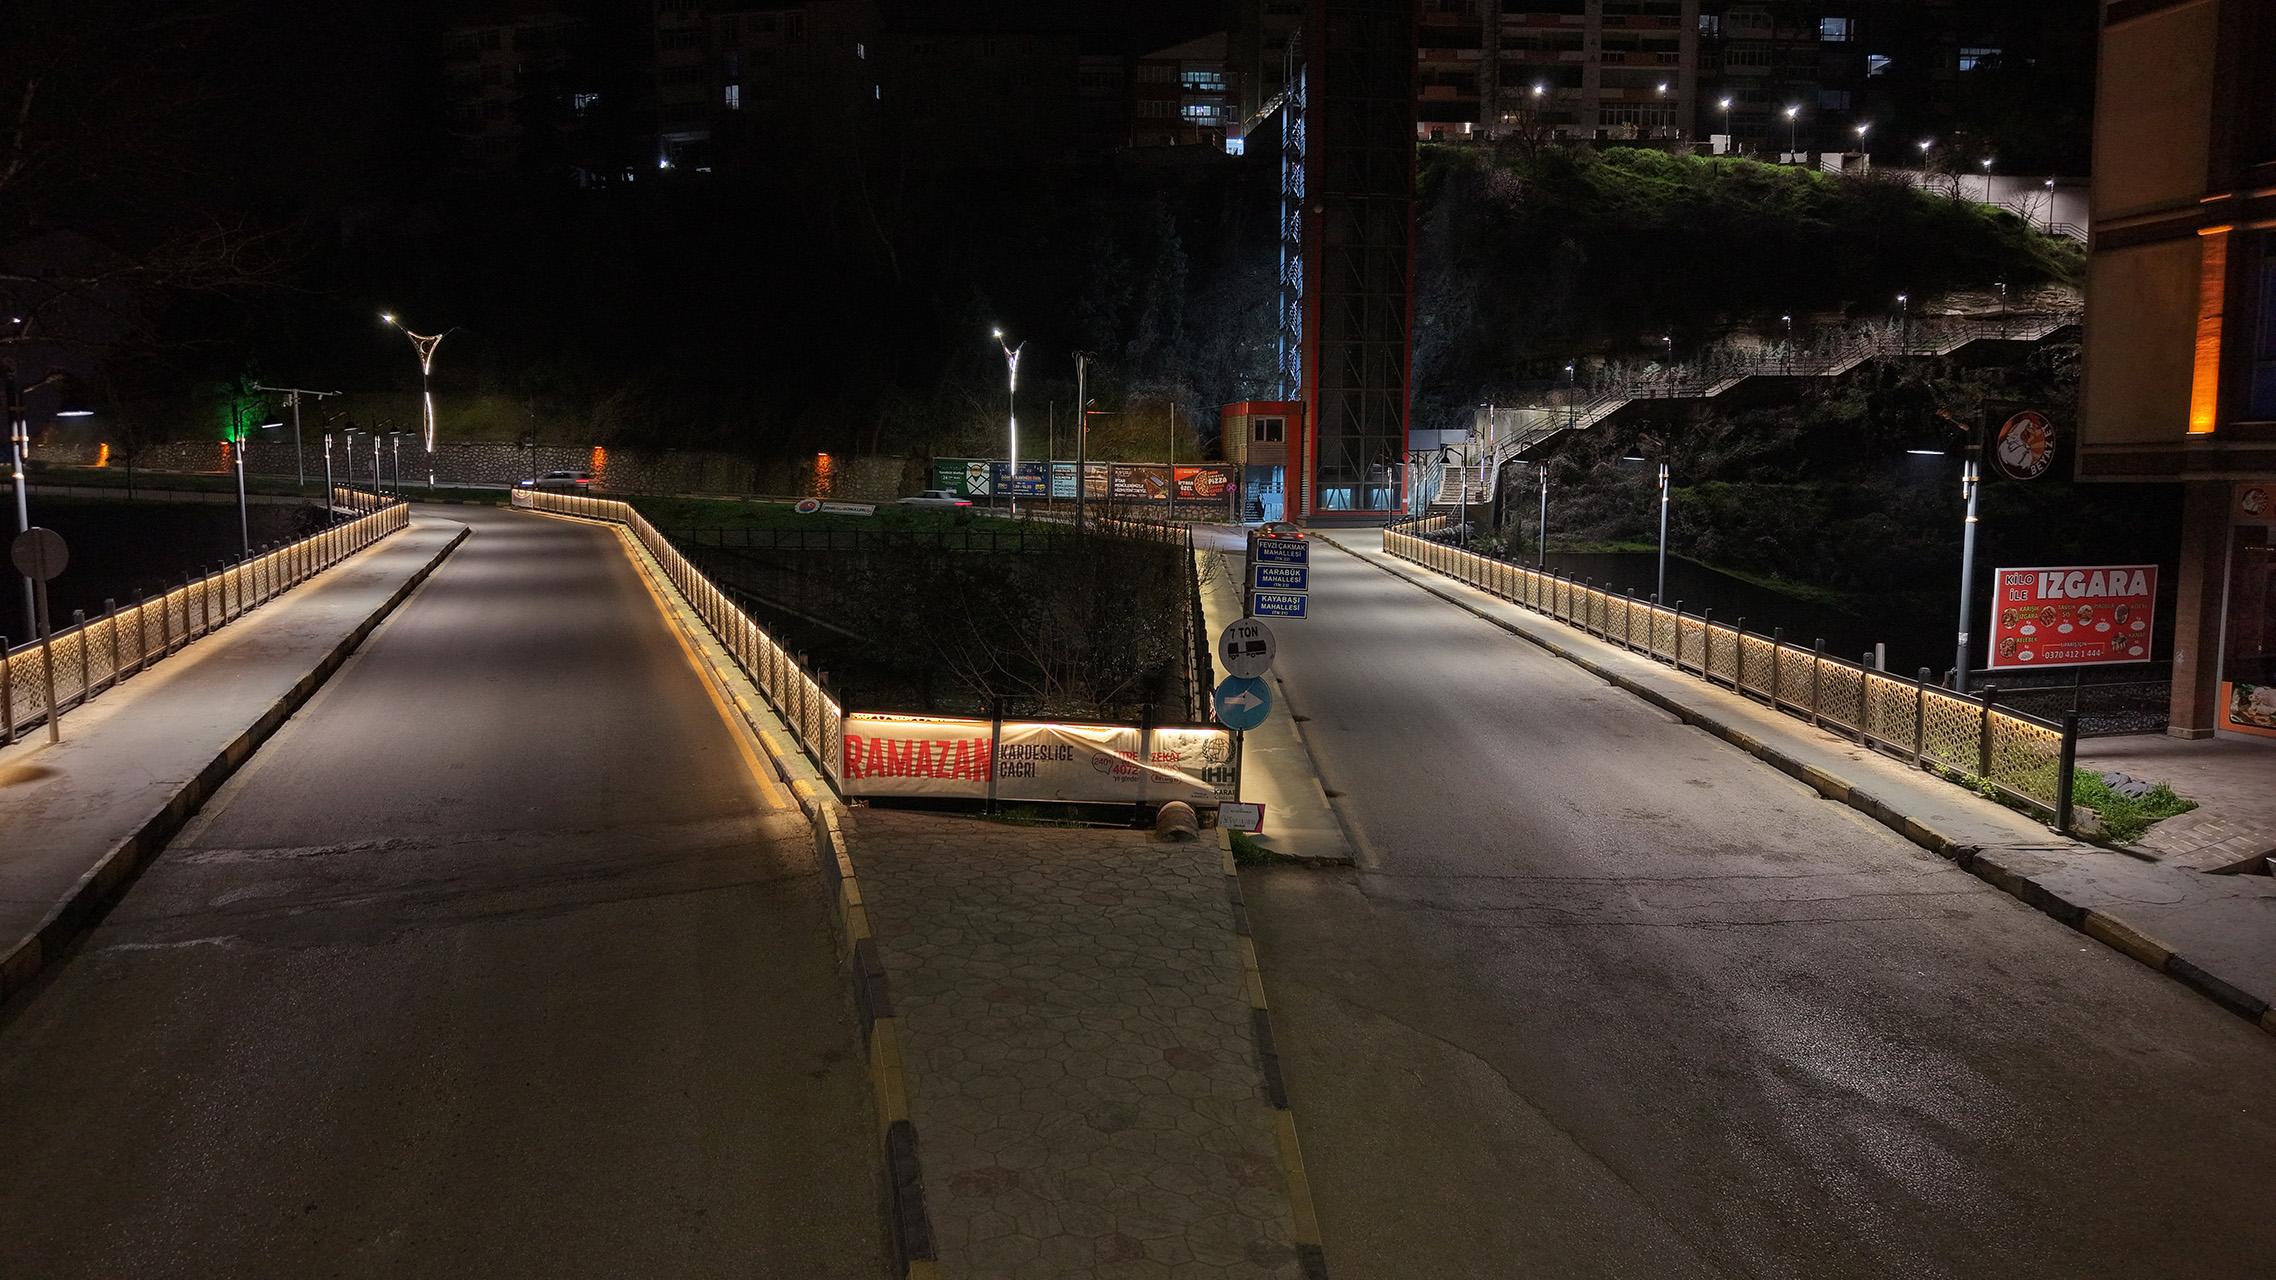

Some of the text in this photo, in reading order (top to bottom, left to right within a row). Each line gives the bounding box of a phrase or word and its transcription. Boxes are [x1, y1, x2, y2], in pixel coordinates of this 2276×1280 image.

[2030, 423, 2053, 475] BEYAZ ET
[1259, 541, 1306, 551] FEVZİ ÇAKMAK
[1264, 549, 1302, 557] MAHALLESİ
[1263, 568, 1301, 576] KARABÜK
[1262, 575, 1301, 583] MAHALLESİ
[2005, 572, 2034, 586] KİLO
[2036, 569, 2148, 600] IZGARA
[1261, 595, 1300, 604] KAYABAŞI
[2009, 588, 2028, 601] İLE
[1260, 603, 1300, 611] MAHALLESİ
[1230, 626, 1259, 639] 7 TON
[2045, 651, 2064, 659] 0370
[2065, 650, 2079, 658] 412
[2087, 649, 2101, 657] 444
[843, 734, 994, 782] RAMAZAN
[1000, 743, 1074, 763] KARDEŞLİĞE
[1000, 760, 1036, 779] ÇAĞRI
[1113, 765, 1139, 775] 4072
